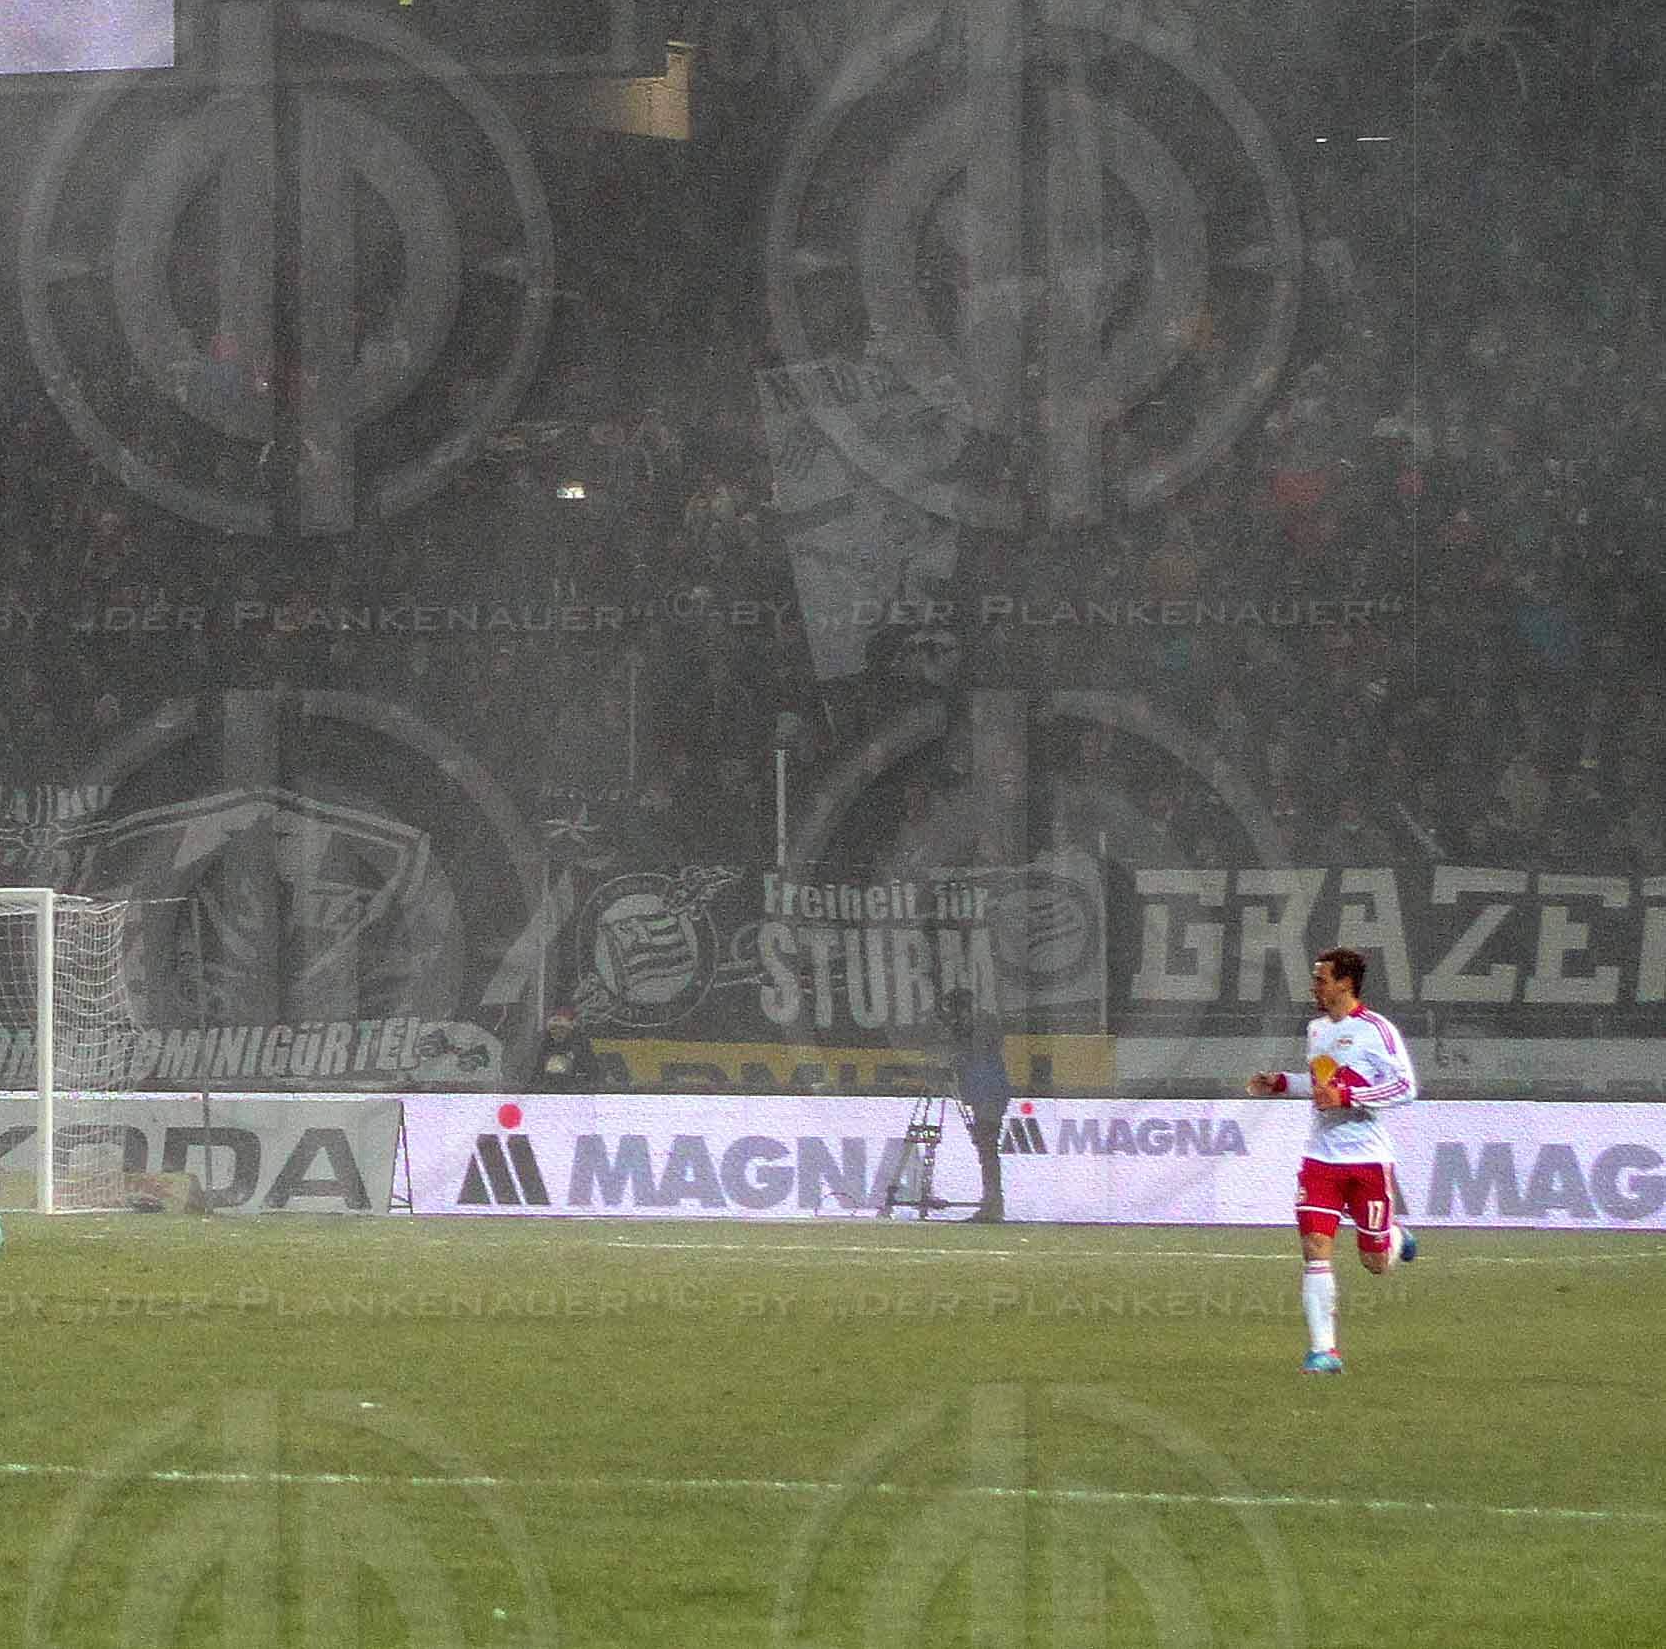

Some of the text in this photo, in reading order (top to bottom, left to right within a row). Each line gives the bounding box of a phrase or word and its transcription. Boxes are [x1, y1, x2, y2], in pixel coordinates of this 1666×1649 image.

[763, 873, 918, 920] Freiheit
[757, 920, 1000, 1028] STURM
[1057, 1118, 1249, 1157] MAGNA
[568, 1134, 926, 1210] MAGNA
[1367, 1198, 1385, 1230] 17
